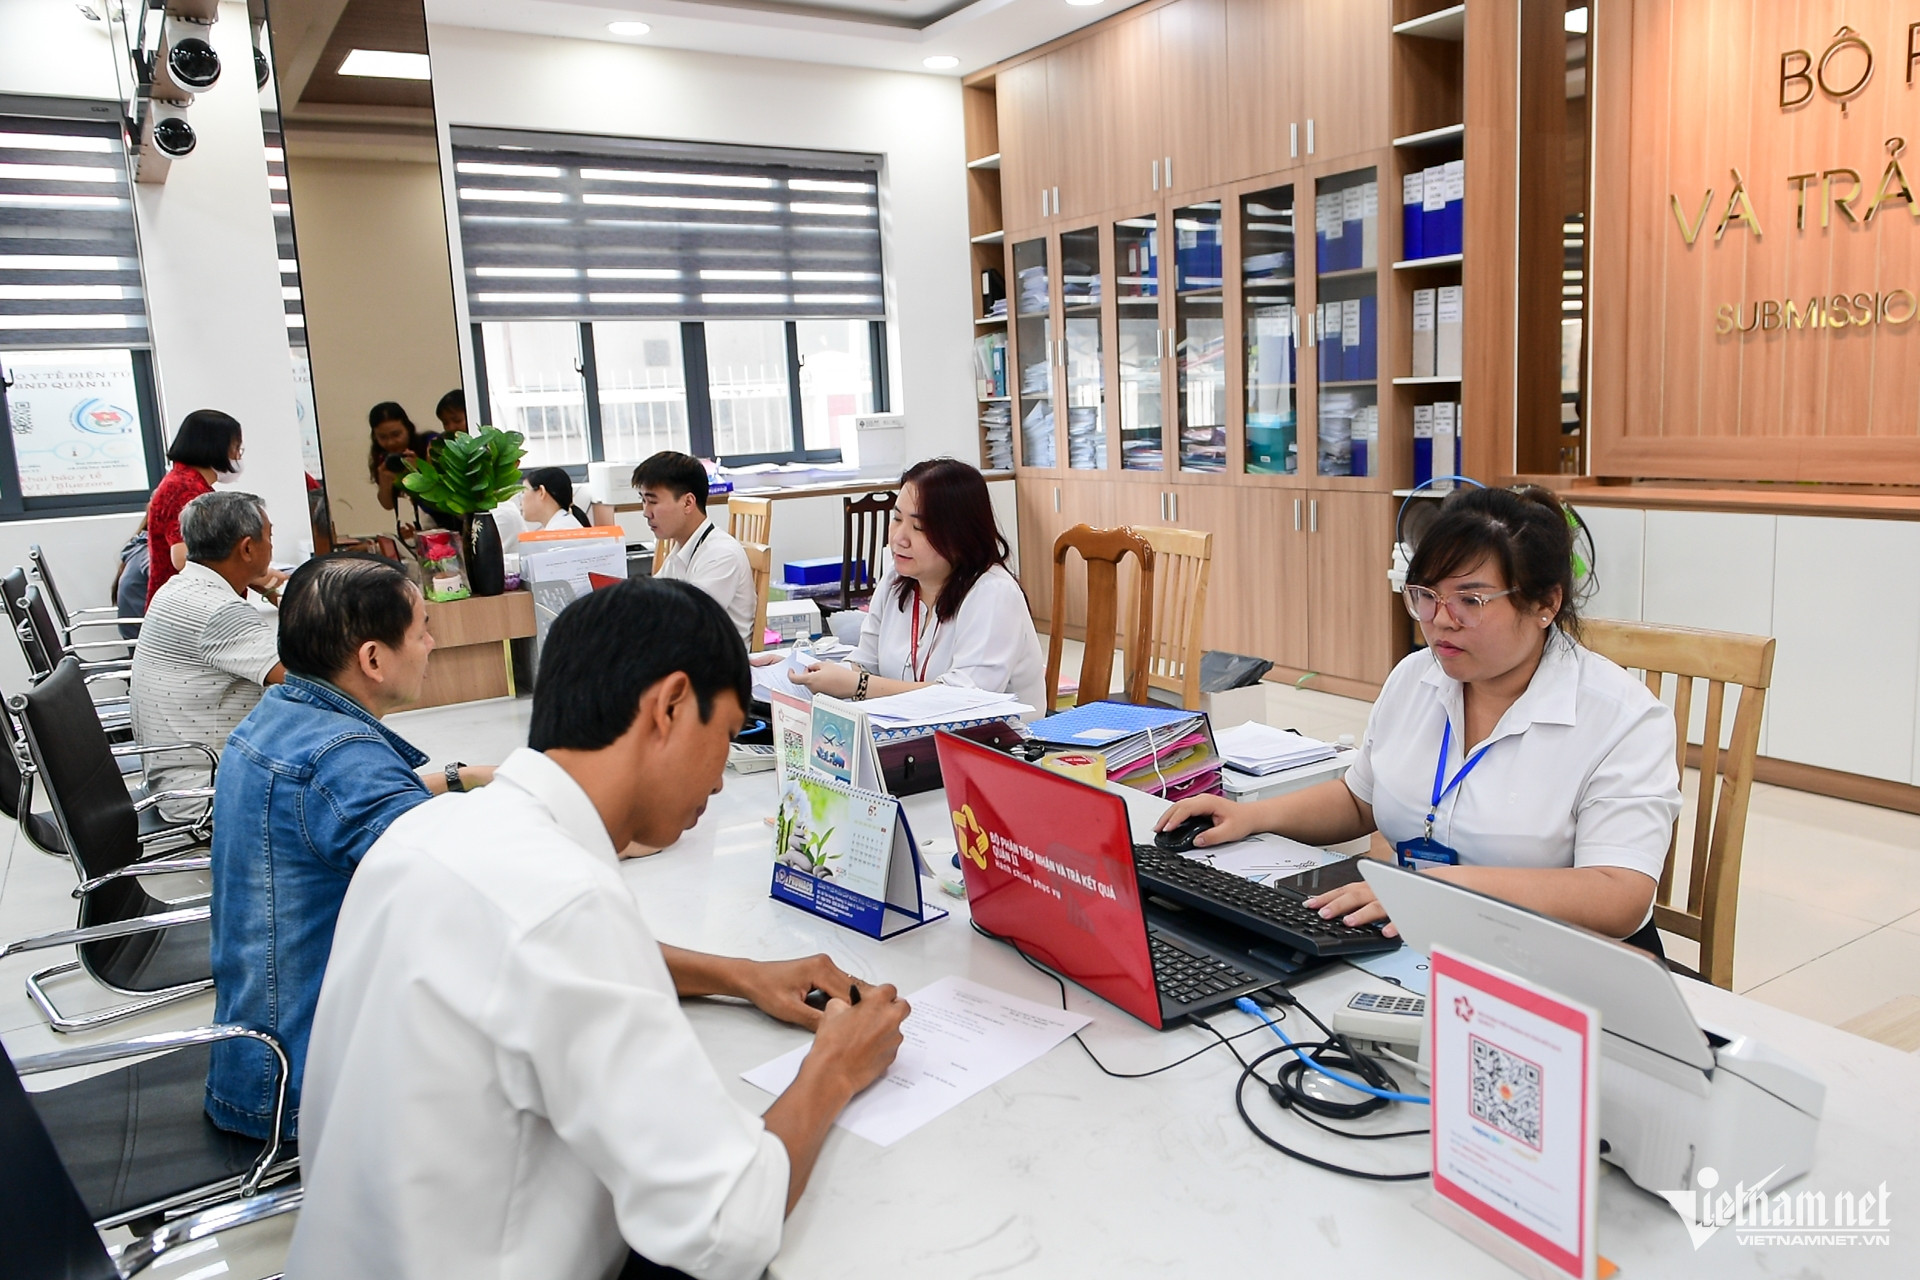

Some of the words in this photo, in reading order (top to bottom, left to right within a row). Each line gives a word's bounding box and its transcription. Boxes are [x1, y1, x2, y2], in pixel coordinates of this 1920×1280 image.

[1779, 25, 1873, 112] BỘ
[1670, 168, 1761, 243] VÀ
[1787, 137, 1920, 230] TRẢ
[1715, 289, 1920, 335] SUBMISSIO
[51, 381, 96, 390] QUẬN
[56, 480, 113, 490] Bluezone
[989, 831, 1000, 847] BỘ
[1018, 845, 1035, 861] TIẾP
[1034, 852, 1056, 873] NHẬN
[1055, 861, 1067, 878] VÀ
[1081, 874, 1097, 891] KẾT
[992, 844, 1011, 863] QUẬN
[1010, 852, 1020, 867] 11
